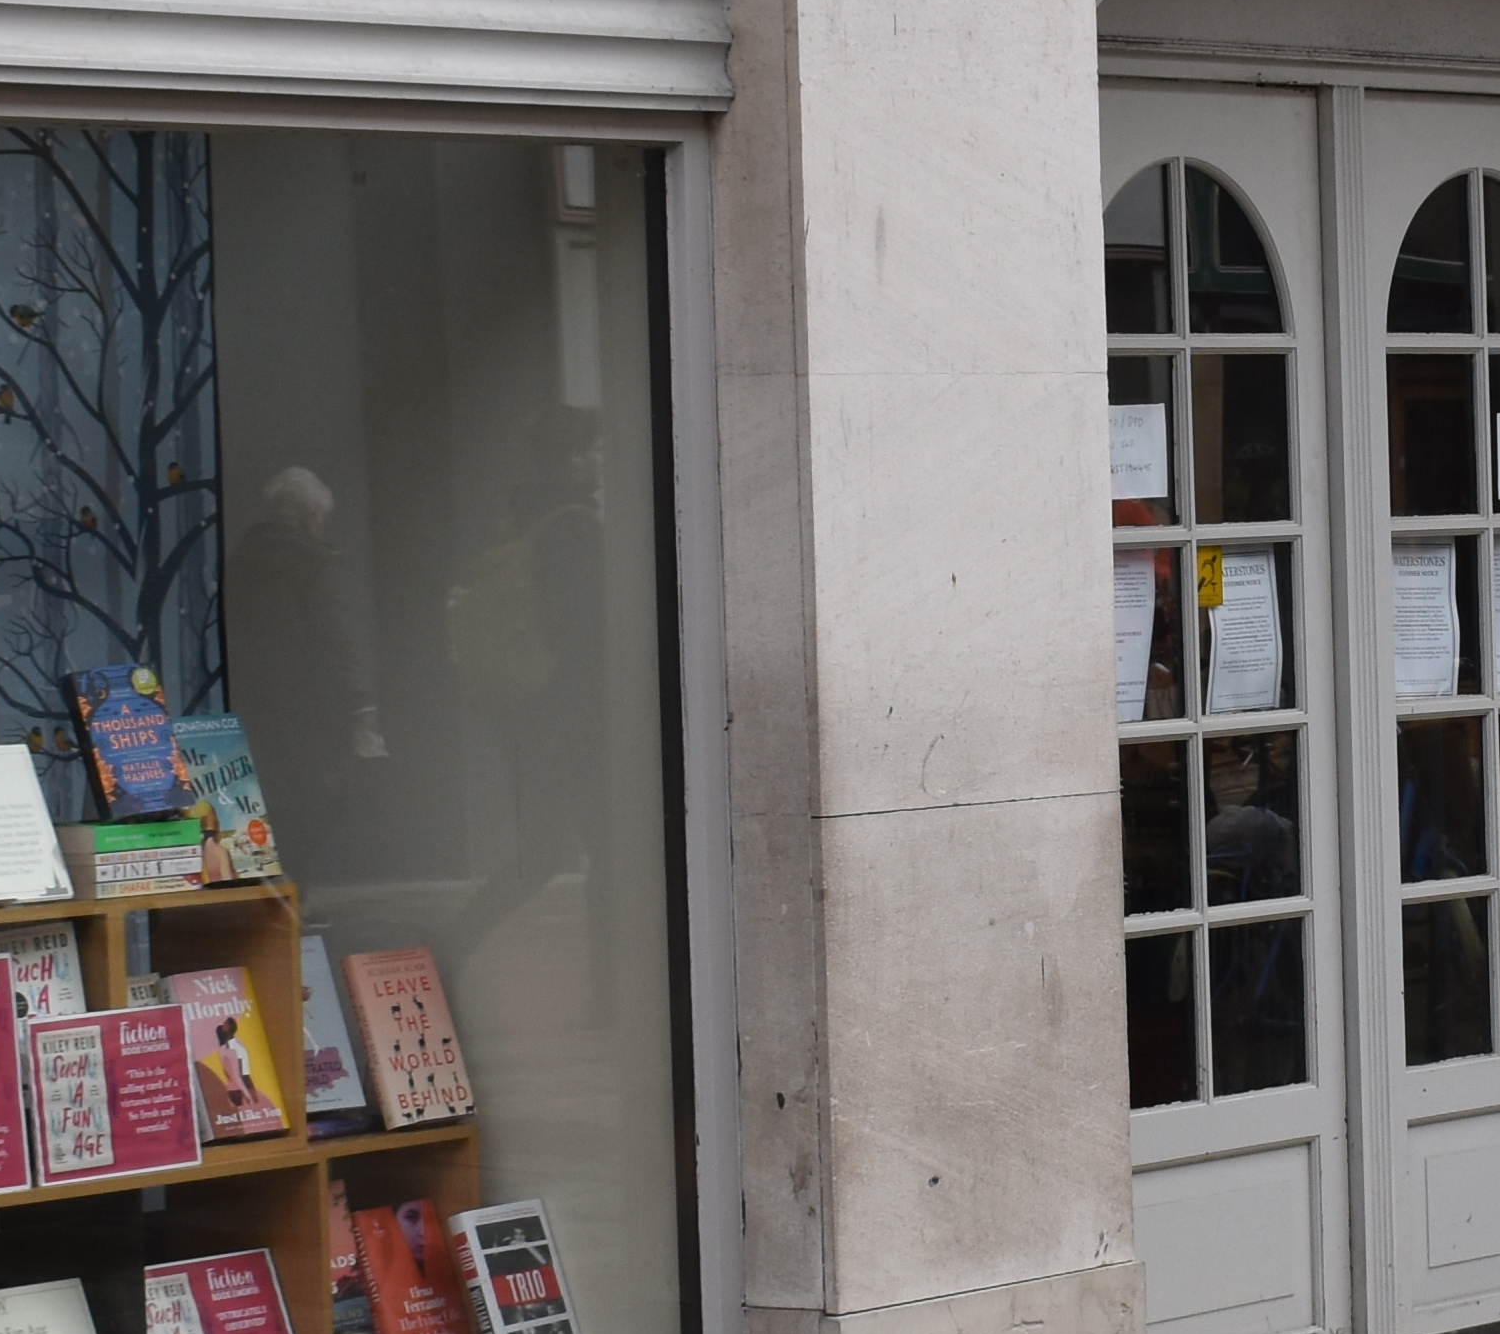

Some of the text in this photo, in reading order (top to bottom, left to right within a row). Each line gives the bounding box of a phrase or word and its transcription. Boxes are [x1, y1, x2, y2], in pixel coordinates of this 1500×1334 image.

[1221, 564, 1266, 577] ATERSTONES
[1393, 555, 1446, 568] WATERSTONES
[120, 703, 130, 715] A
[92, 713, 166, 732] THOUSAND
[173, 717, 240, 734] JONATHAN COE
[109, 730, 159, 750] SHIPS
[122, 760, 161, 772] NATALIE
[181, 748, 207, 768] Mr
[124, 769, 166, 783] HAYNES
[190, 754, 254, 798] WILDER
[217, 786, 235, 805] &
[235, 795, 261, 815] Me
[33, 931, 69, 952] REID
[129, 984, 158, 1001] REID
[193, 974, 238, 996] Nick
[372, 975, 432, 998] LEAVE
[183, 996, 253, 1022] Hornby
[119, 1020, 167, 1045] Fiction
[394, 1013, 431, 1032] THE
[41, 1035, 97, 1055] KILEY REID
[388, 1048, 456, 1072] WORLD
[397, 1085, 468, 1110] BEHIND
[215, 1107, 283, 1125] Just Like You
[72, 1130, 106, 1159] AGE
[459, 1239, 477, 1274] TRIO
[205, 1266, 255, 1291] Fiction
[505, 1269, 546, 1304] TRIO
[163, 1282, 187, 1298] REID
[409, 1285, 434, 1298] Elena
[403, 1296, 447, 1315] Ferrante
